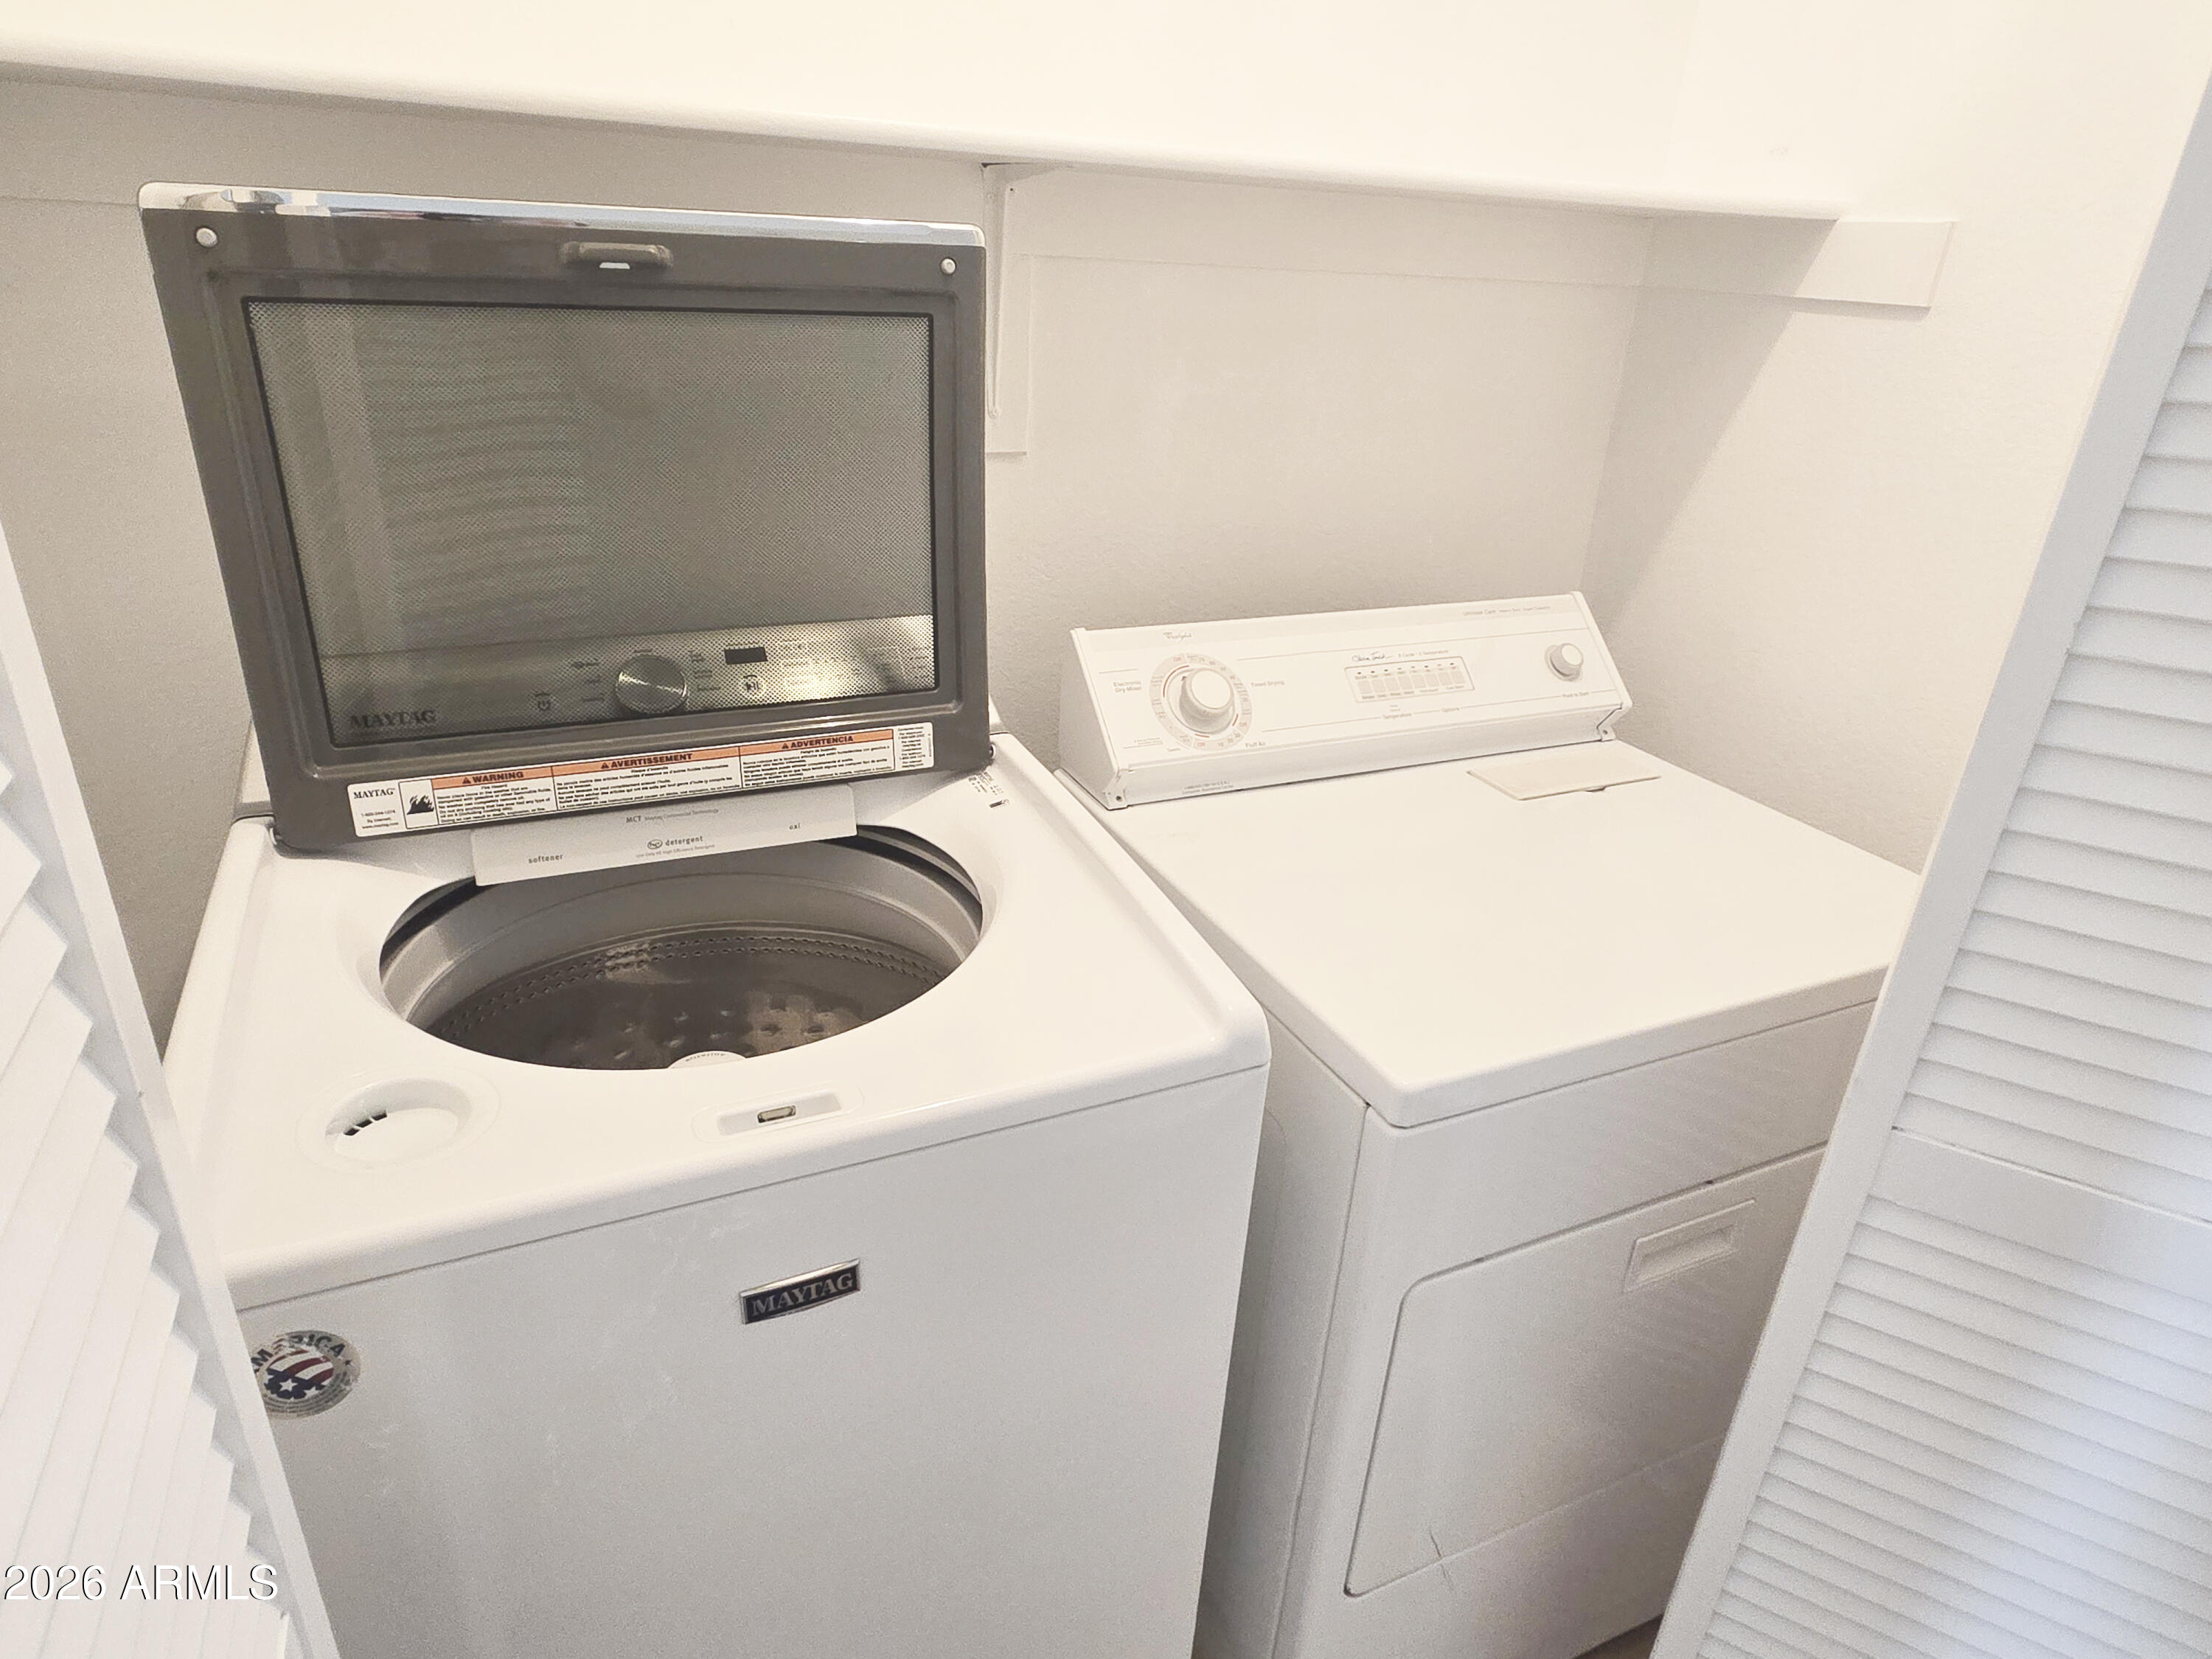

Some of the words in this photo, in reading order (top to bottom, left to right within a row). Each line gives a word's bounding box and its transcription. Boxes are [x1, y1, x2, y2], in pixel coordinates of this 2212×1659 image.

[349, 710, 437, 728] MAYTAG
[790, 736, 854, 748] ADVERTENCIA
[611, 754, 693, 768] AVERTISSEMENT
[472, 771, 524, 784] WARNING
[354, 788, 394, 799] MAYTAG
[626, 815, 641, 824] MCT
[665, 835, 703, 846] detergent
[528, 853, 564, 864] softener
[751, 1273, 854, 1316] MAYTAG
